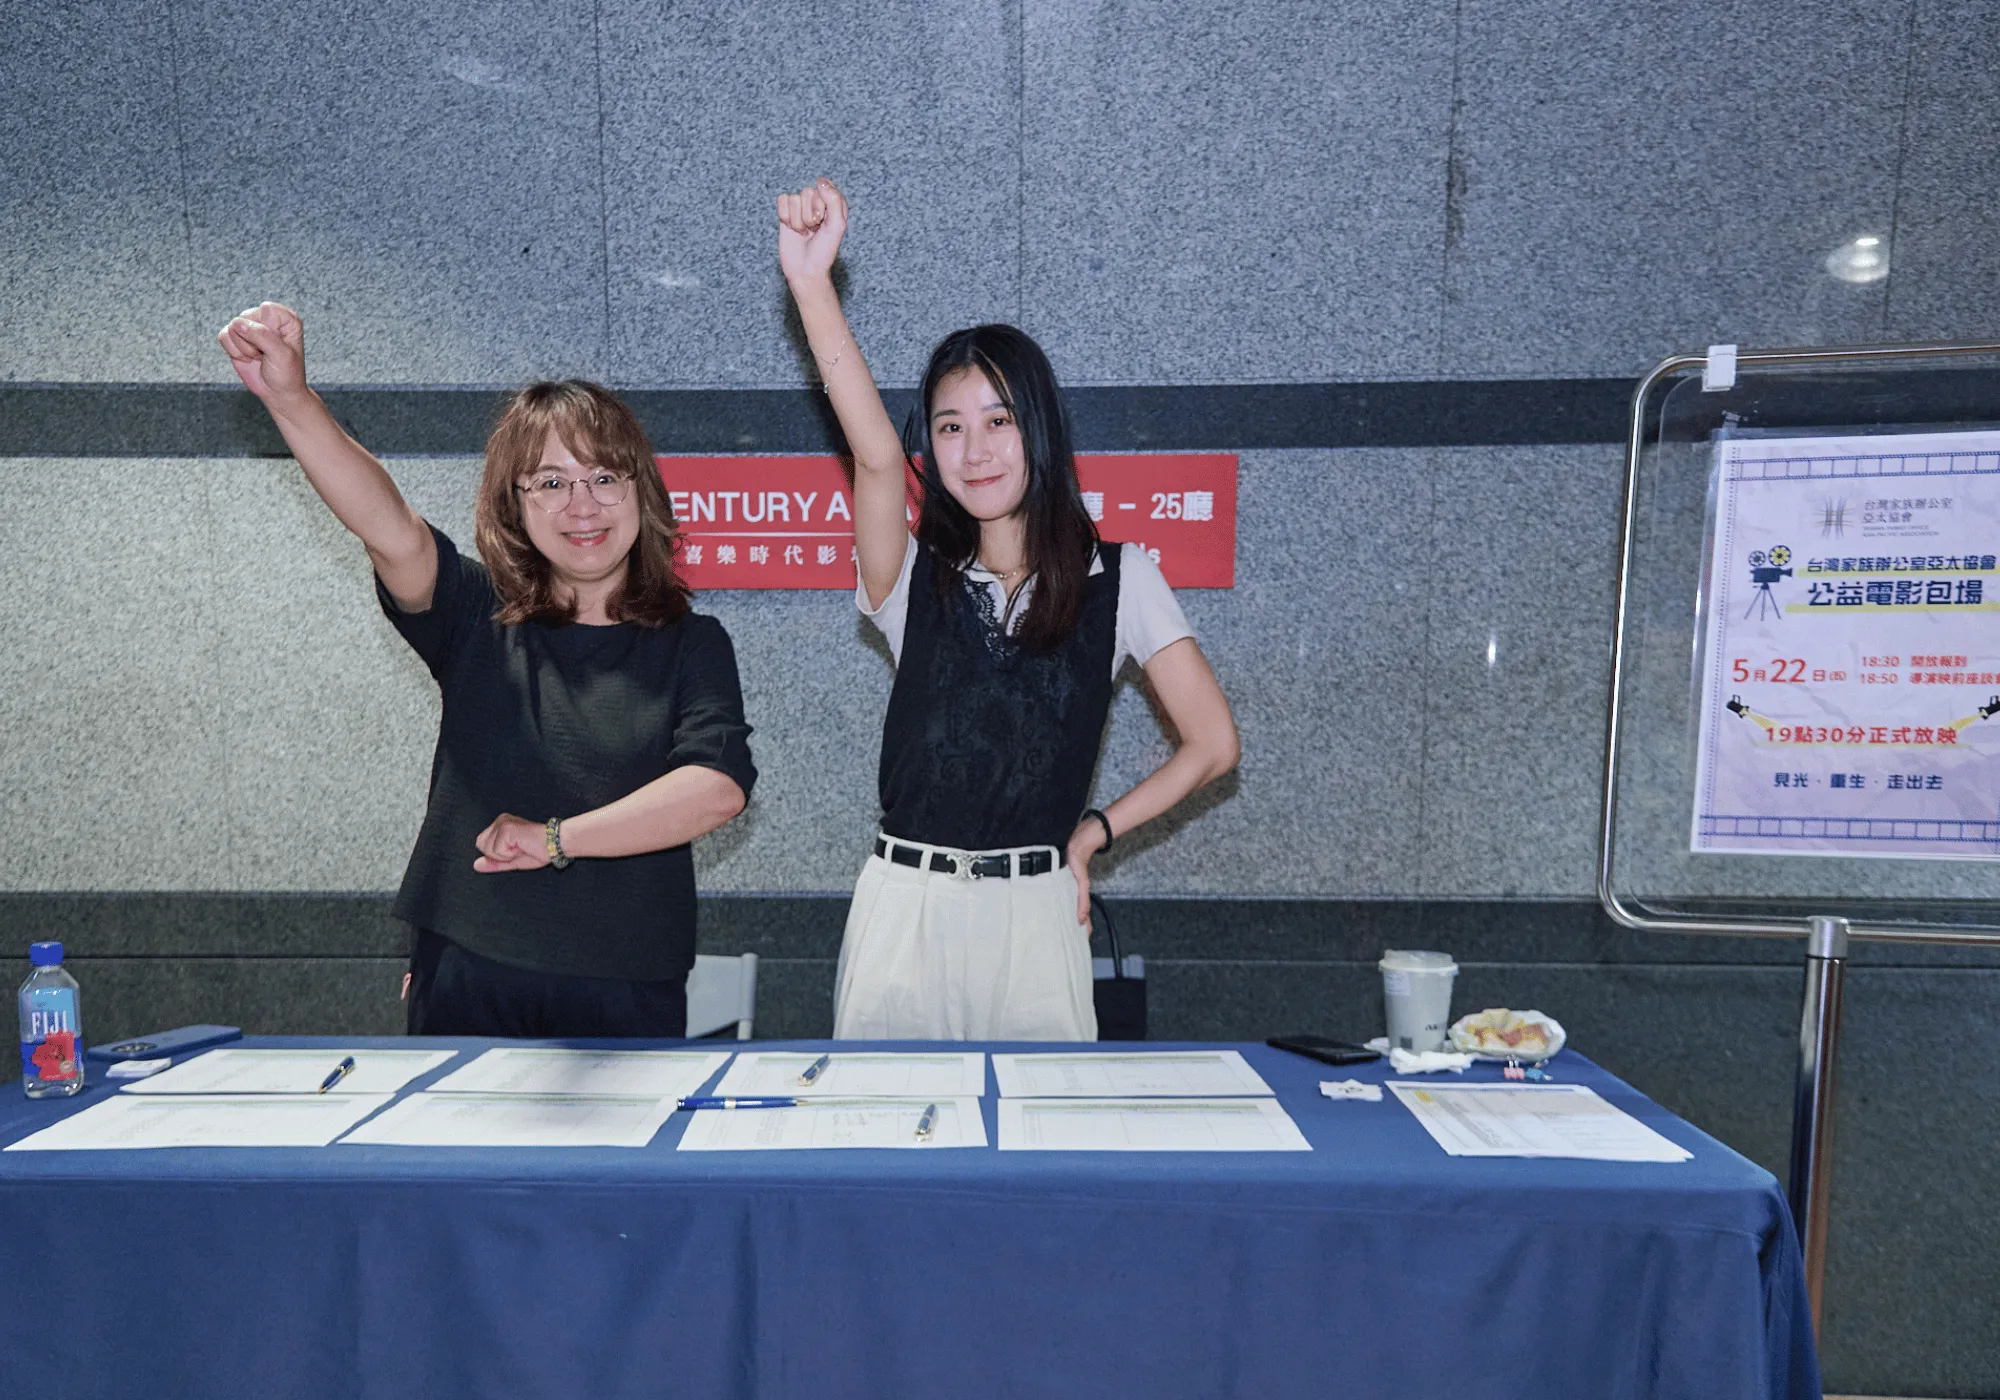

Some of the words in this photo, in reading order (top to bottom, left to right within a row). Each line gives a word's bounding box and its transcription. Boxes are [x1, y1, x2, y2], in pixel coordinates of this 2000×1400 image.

[670, 491, 818, 522] ENTURY
[1150, 490, 1214, 521] 25廳
[1807, 554, 1996, 573] 台灣家族辦公室亞太協會
[1807, 579, 1983, 606] 公益電影包場
[1862, 655, 1900, 667] 18:30
[1860, 673, 1899, 685] 18:50
[1766, 726, 1958, 745] 19點30分正式放映
[31, 1010, 69, 1035] FIJI
